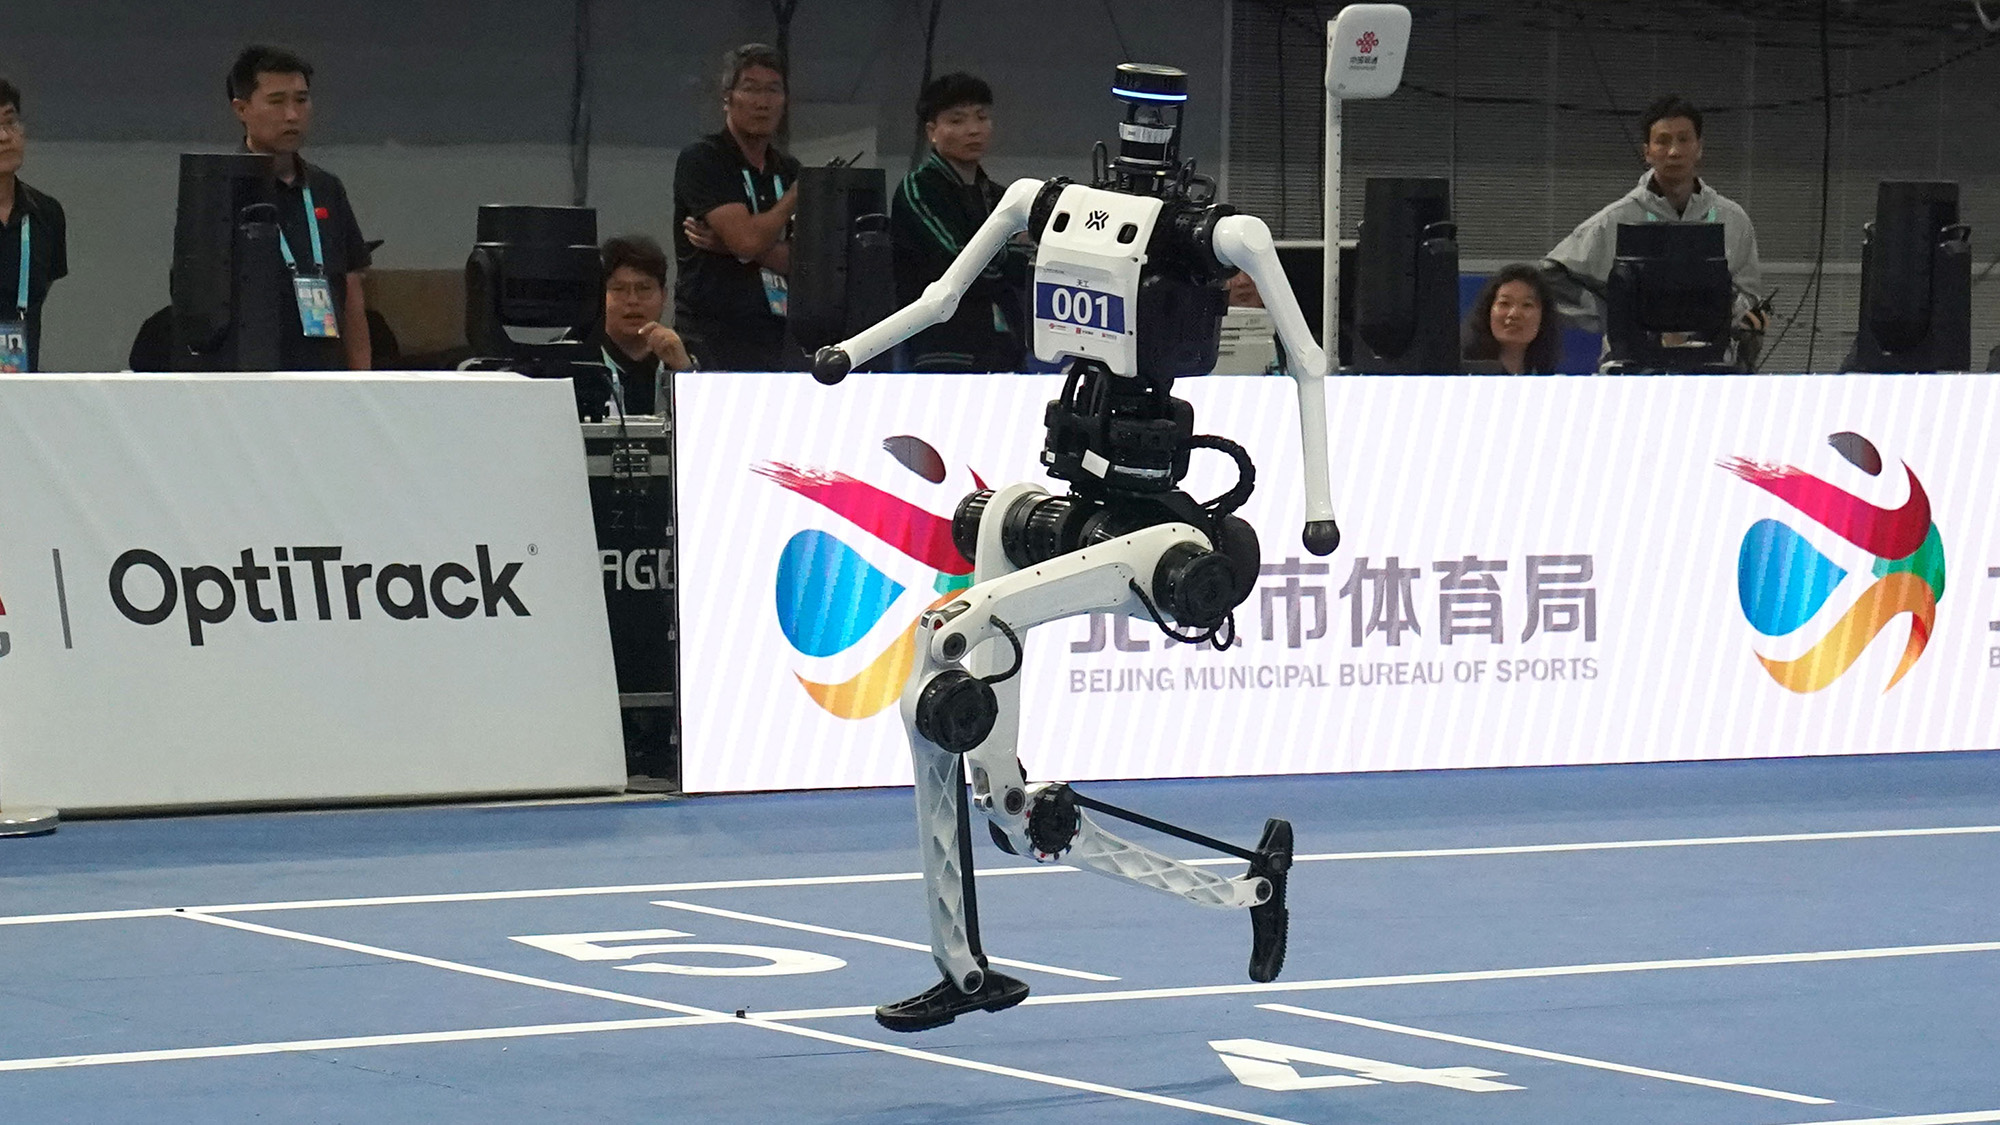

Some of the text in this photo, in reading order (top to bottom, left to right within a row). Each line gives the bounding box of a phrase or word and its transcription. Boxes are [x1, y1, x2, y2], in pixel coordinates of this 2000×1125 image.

[1052, 287, 1108, 328] 001
[1070, 657, 1598, 692] BEIJING MUNICIPAL BUREAU OF SPORTS
[507, 928, 847, 977] 5
[1207, 1038, 1528, 1092] 4
